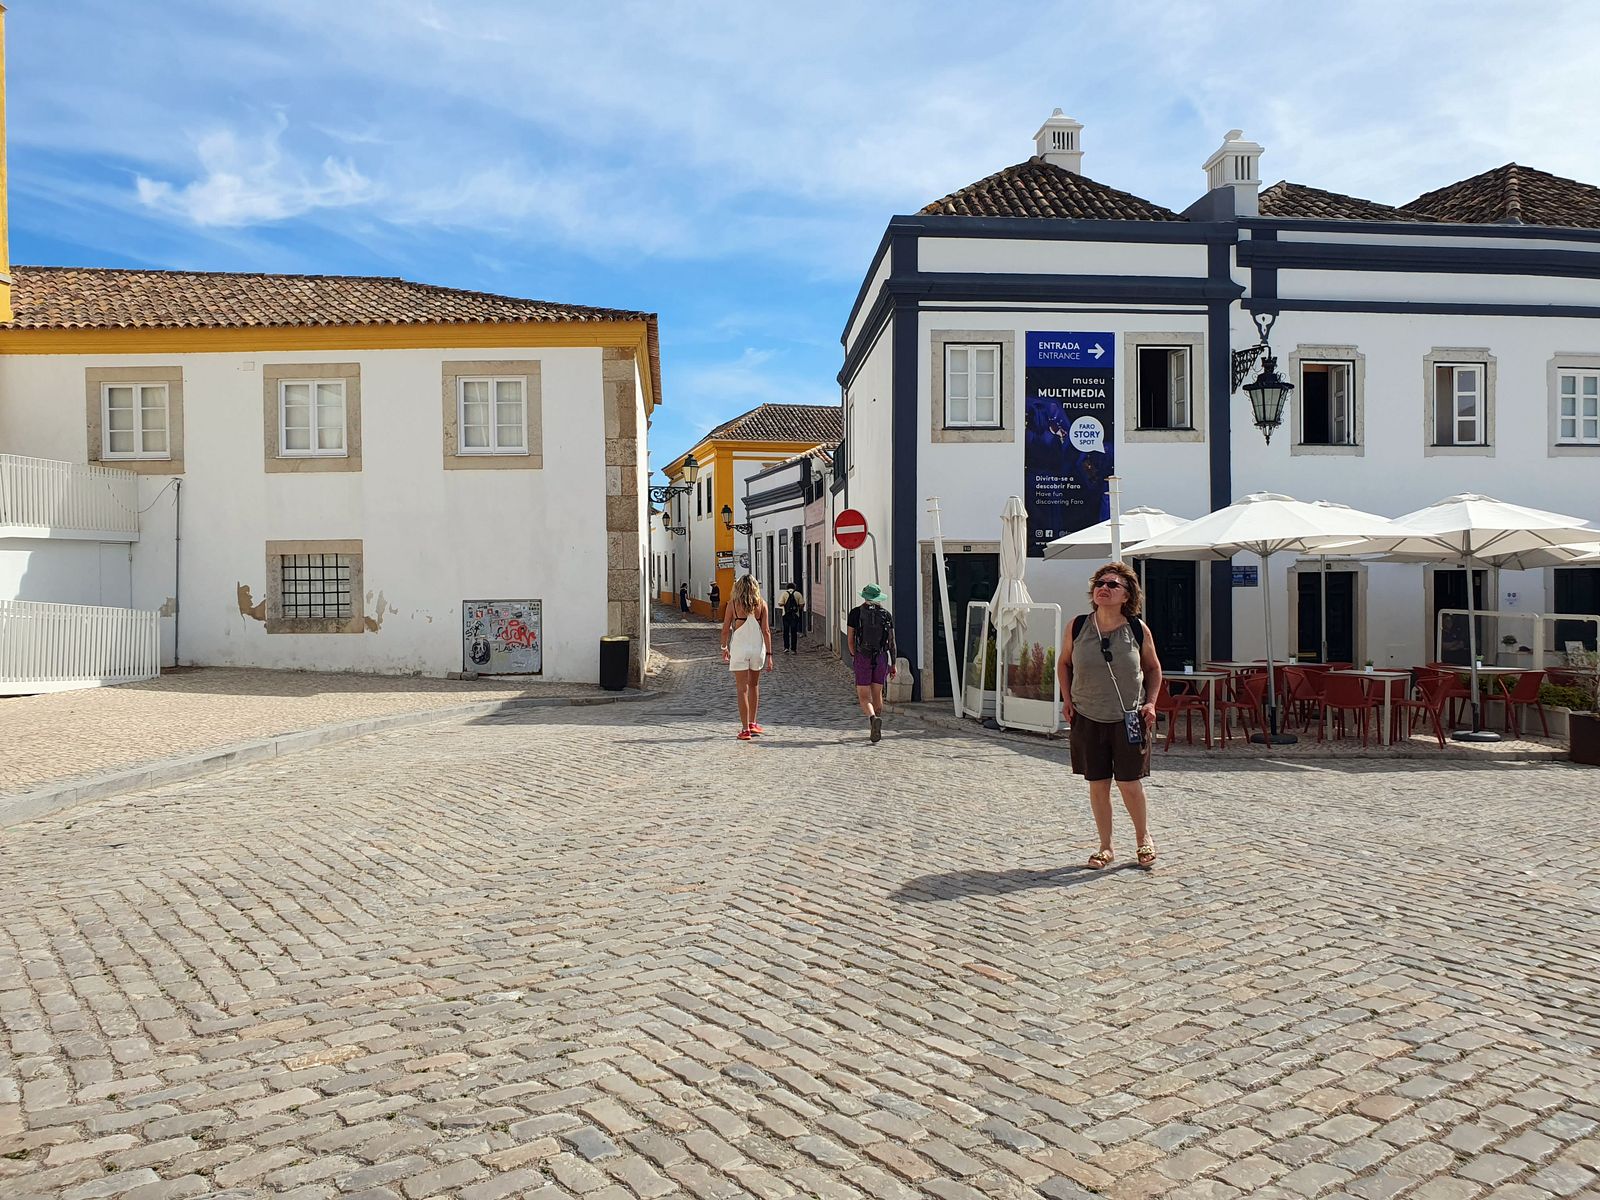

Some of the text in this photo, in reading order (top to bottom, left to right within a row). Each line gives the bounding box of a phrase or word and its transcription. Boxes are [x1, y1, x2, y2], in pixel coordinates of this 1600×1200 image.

[1038, 341, 1080, 350] ENTRADA
[1038, 351, 1081, 360] ENTRANCE
[1072, 377, 1105, 385] museu
[1038, 388, 1106, 398] MULTIMEDIA
[1073, 430, 1101, 438] STORY
[1035, 498, 1069, 506] discovering
